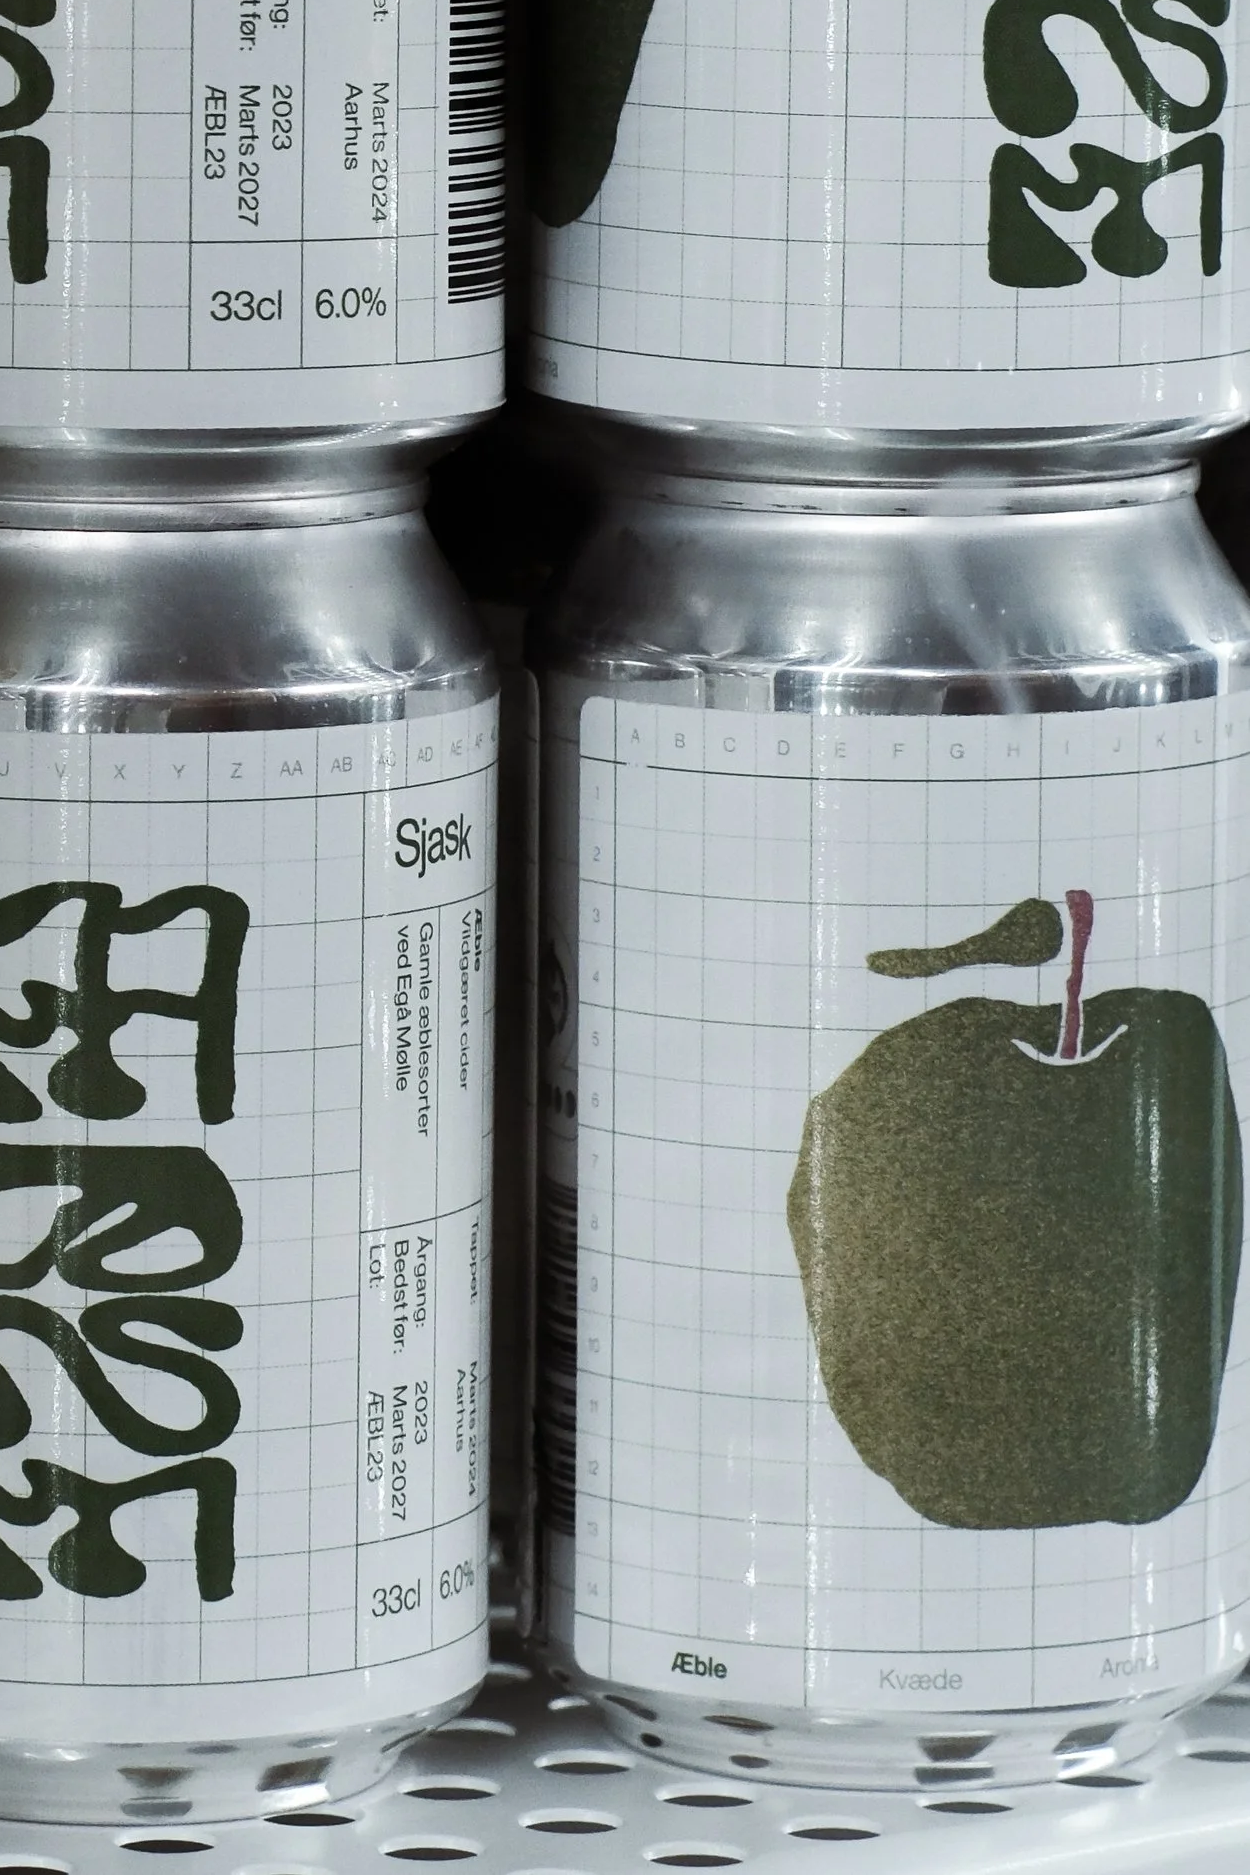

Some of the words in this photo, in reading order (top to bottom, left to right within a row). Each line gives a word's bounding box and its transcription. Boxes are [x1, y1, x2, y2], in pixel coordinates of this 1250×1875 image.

[239, 11, 261, 52] før:
[203, 85, 227, 181] ÆBL23
[239, 85, 262, 157] Marts
[271, 84, 294, 151] 2023
[343, 83, 363, 170] Aarhus
[371, 82, 390, 153] Marts
[237, 162, 260, 227] 2027
[370, 158, 389, 223] 2024
[209, 290, 283, 322] 33cl
[314, 286, 387, 320] 6.0%
[113, 764, 126, 780] X
[173, 763, 186, 779] Y
[230, 762, 243, 779] Z
[280, 760, 304, 777] AA
[330, 756, 353, 774] AB
[416, 746, 434, 763] AD
[450, 739, 463, 757] AE
[630, 728, 640, 744] A
[674, 732, 686, 749] B
[723, 736, 736, 753] C
[777, 739, 790, 756] D
[835, 742, 846, 759] E
[892, 742, 905, 758] F
[950, 742, 966, 760] G
[1007, 743, 1020, 758] H
[1112, 737, 1122, 753] J
[1156, 732, 1166, 749] K
[1195, 729, 1203, 744] L
[394, 813, 472, 878] Sjask
[592, 846, 601, 862] 2
[396, 925, 413, 969] ved
[474, 908, 484, 972] Æble
[592, 908, 601, 924] 3
[417, 922, 434, 1000] Gamle
[458, 911, 472, 1028] Vildgæret
[394, 973, 413, 1021] Egå
[396, 1025, 412, 1092] Mølle
[417, 1004, 434, 1138] æblesorter
[459, 1032, 471, 1092] cider
[368, 1243, 387, 1289] Lot:
[393, 1239, 410, 1313] Bedst
[413, 1236, 434, 1329] Årgang:
[469, 1215, 480, 1305] Tappet:
[393, 1315, 409, 1355] før:
[391, 1385, 408, 1456] Marts
[414, 1380, 429, 1446] 2023
[455, 1369, 467, 1453] Aarhus
[468, 1361, 478, 1430] Marts
[366, 1390, 385, 1483] ÆBL23
[391, 1459, 408, 1521] 2027
[371, 1578, 421, 1618] 33cl
[439, 1559, 475, 1600] 6.0%
[671, 1651, 728, 1679] Æble
[878, 1668, 964, 1691] Kvæde
[1098, 1653, 1160, 1679] Arona
